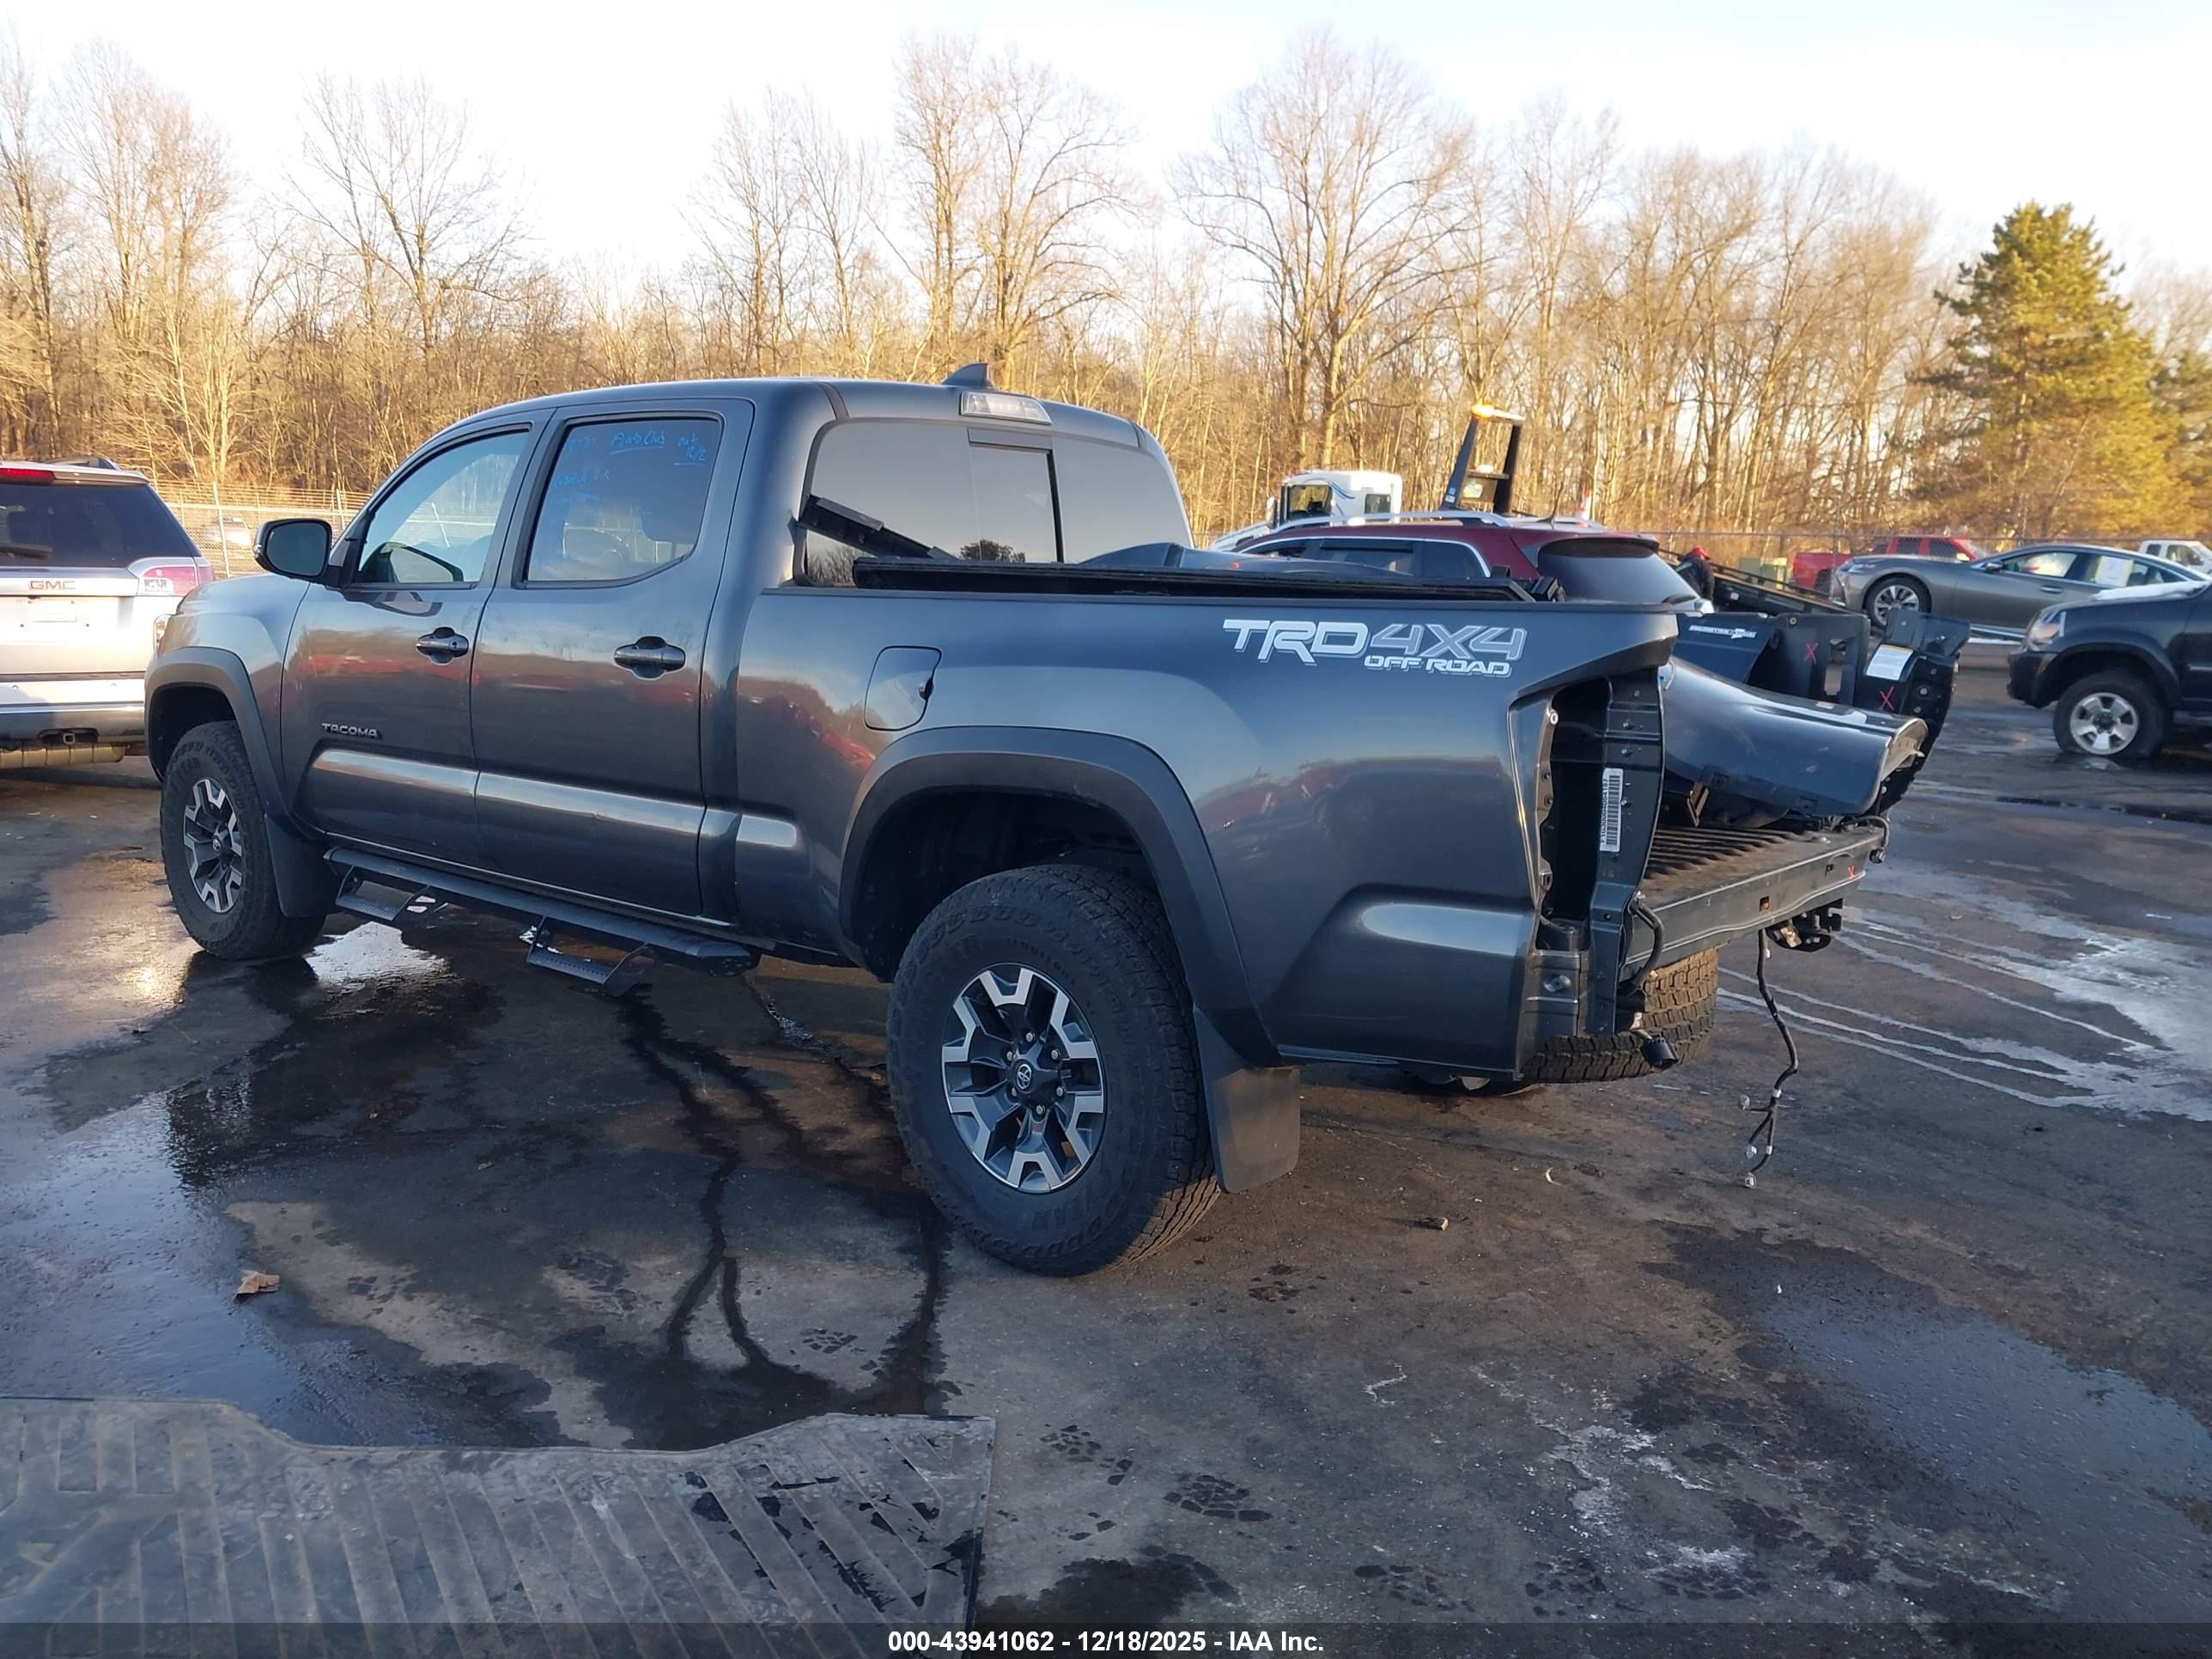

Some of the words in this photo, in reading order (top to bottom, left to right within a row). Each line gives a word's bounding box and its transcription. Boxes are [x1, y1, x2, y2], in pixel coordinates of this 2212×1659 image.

[28, 580, 76, 591] GMC
[1223, 618, 1371, 666] TRD
[1370, 623, 1528, 661] 4X4
[1364, 654, 1423, 672] OFF
[1425, 658, 1513, 678] ROAD
[320, 721, 379, 738] TACOMA
